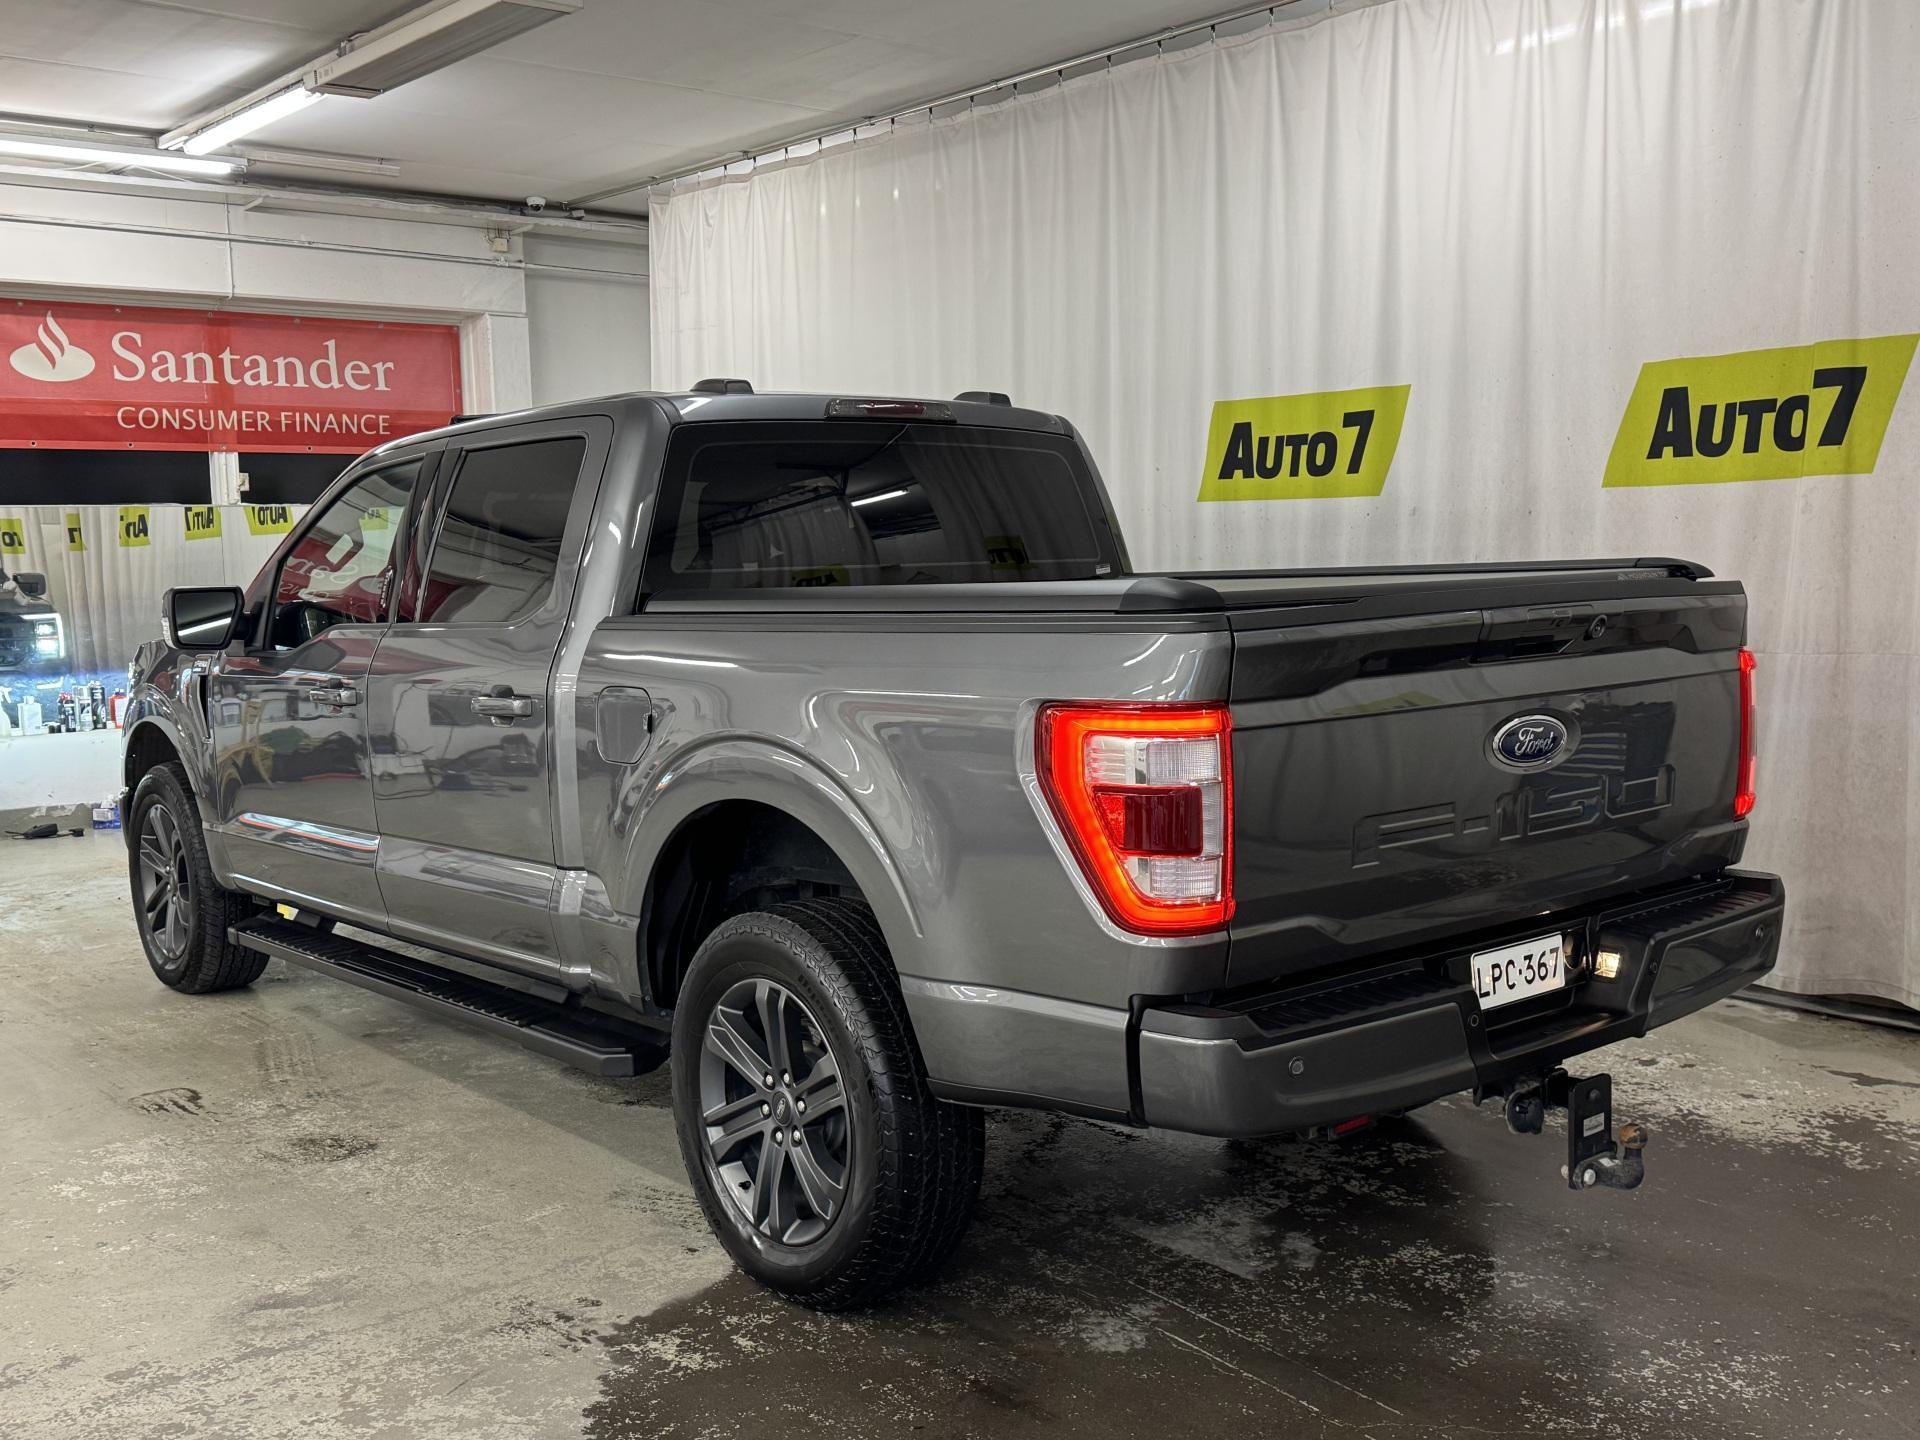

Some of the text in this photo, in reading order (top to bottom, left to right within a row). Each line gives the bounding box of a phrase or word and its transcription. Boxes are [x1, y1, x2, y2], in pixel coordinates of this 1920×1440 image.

[111, 331, 395, 392] Santander
[117, 406, 391, 435] CONSUMER FINANCE
[1514, 726, 1554, 756] Ford
[1352, 764, 1676, 869] F-150
